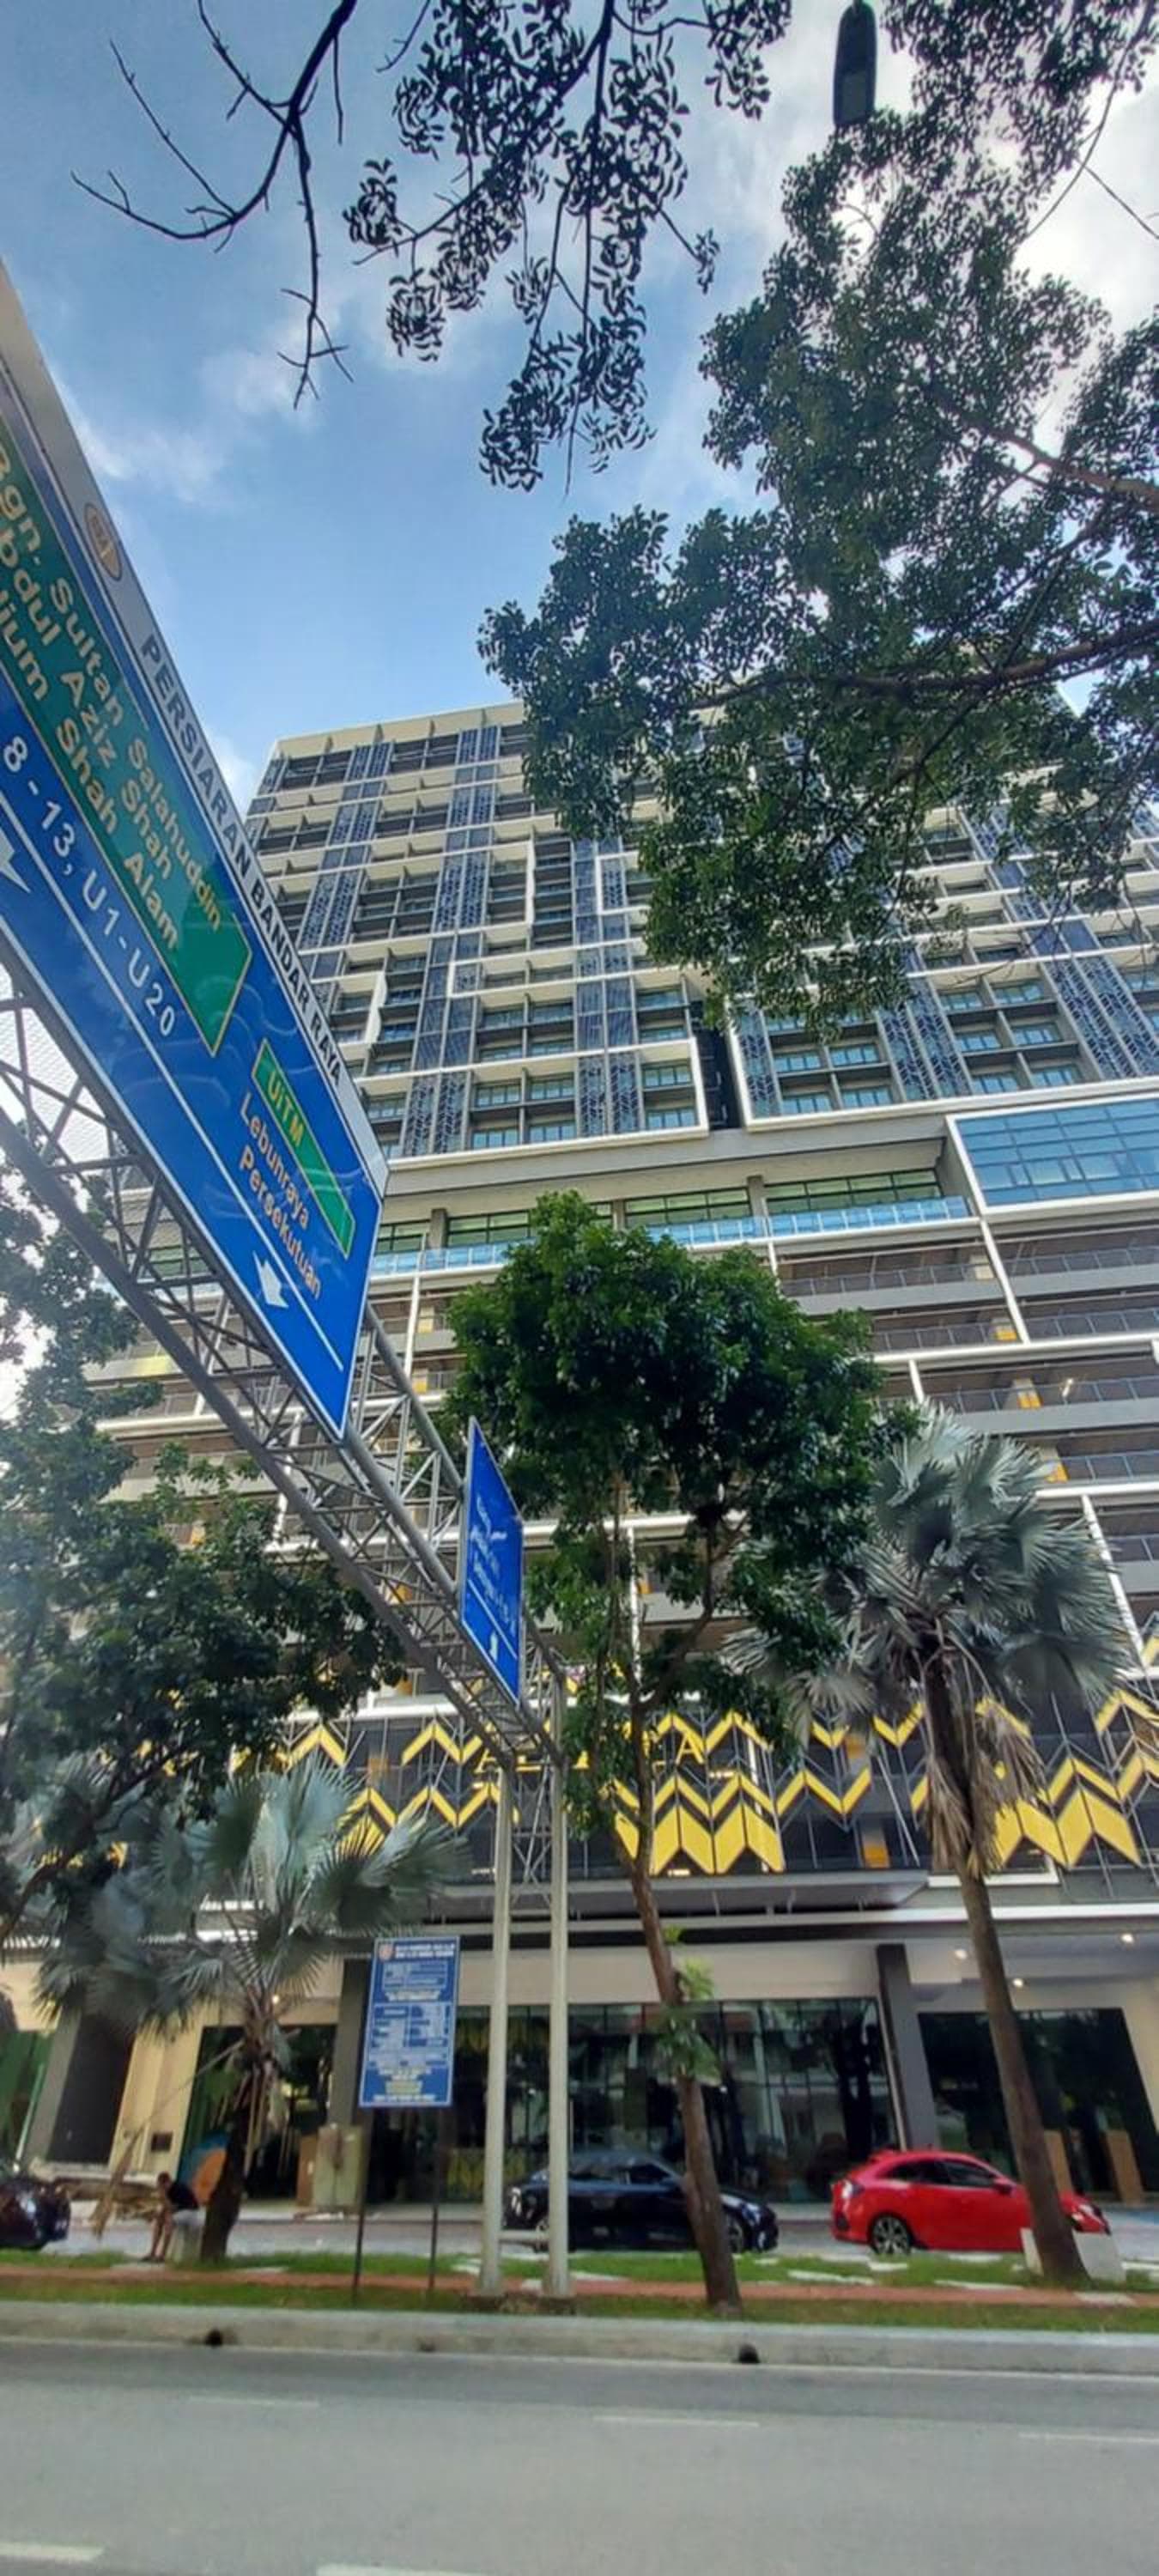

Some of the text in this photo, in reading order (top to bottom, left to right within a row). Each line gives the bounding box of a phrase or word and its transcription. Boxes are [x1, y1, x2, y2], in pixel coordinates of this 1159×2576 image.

[0, 590, 178, 949] ium Shah Alam
[50, 577, 124, 726] Sultan
[128, 738, 221, 931] Salahuddin
[60, 671, 117, 769] Aziz
[121, 779, 172, 879] Shah
[82, 869, 175, 1036] U1-U20
[142, 634, 342, 1085] PERSIARAN BANDAR RAYA
[240, 1092, 309, 1230] Lebuhraya
[240, 1145, 321, 1300] Persekutuan
